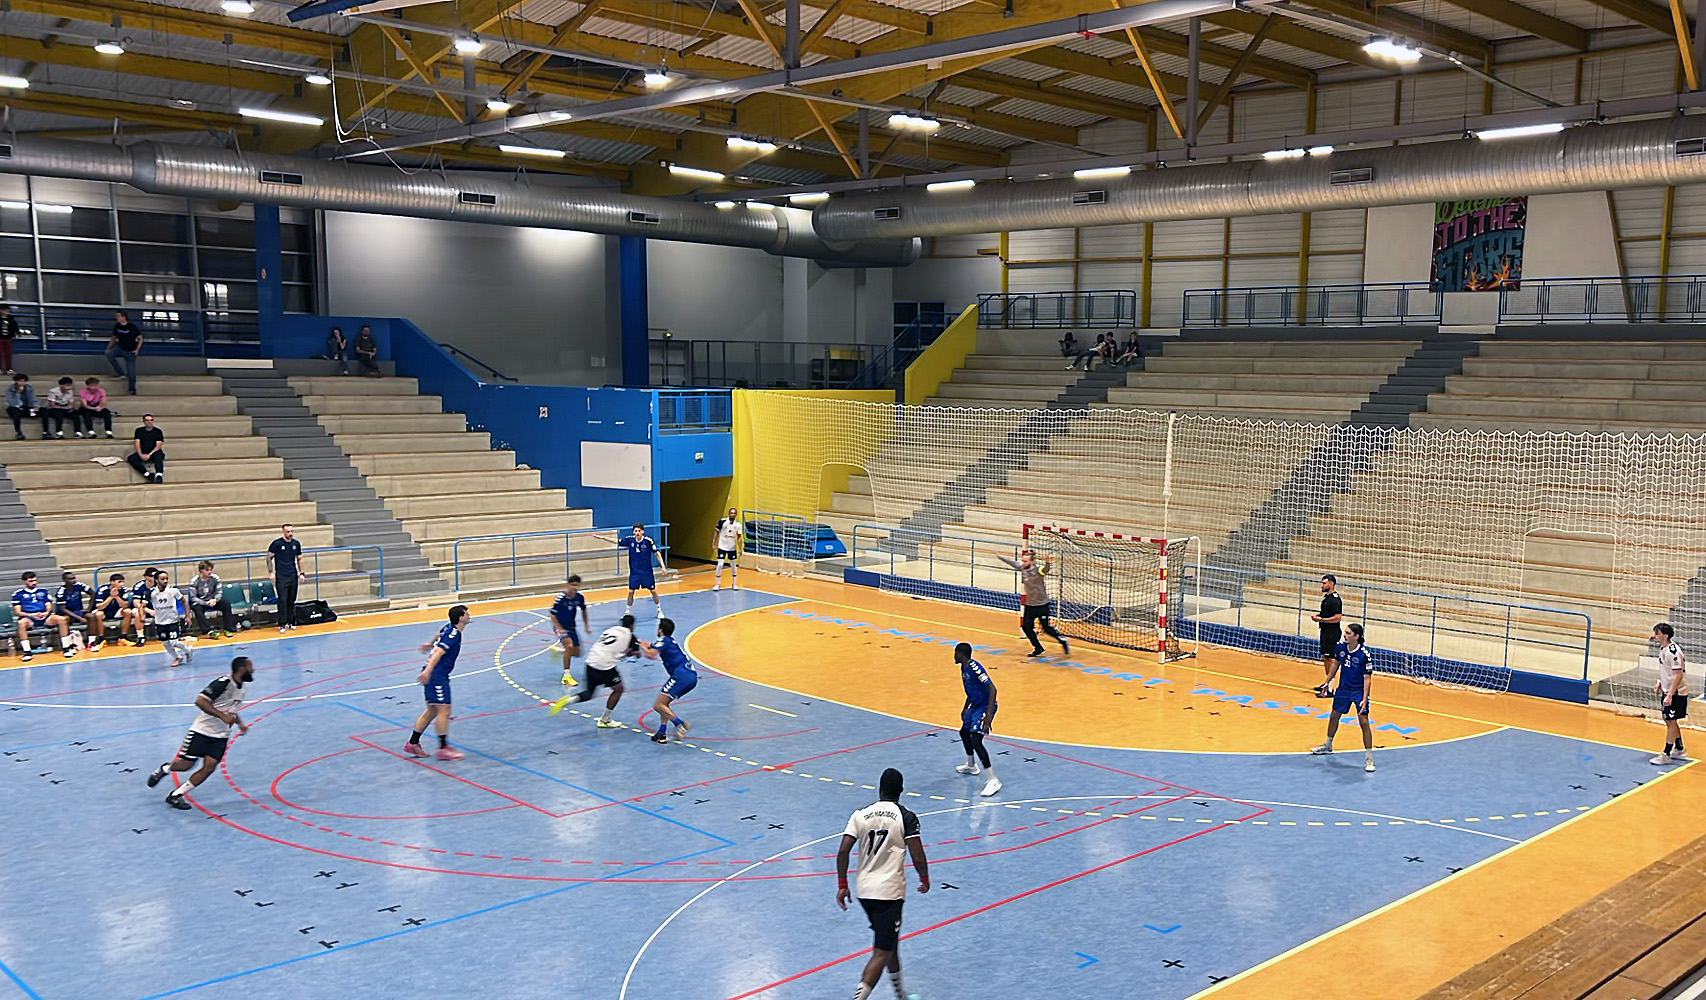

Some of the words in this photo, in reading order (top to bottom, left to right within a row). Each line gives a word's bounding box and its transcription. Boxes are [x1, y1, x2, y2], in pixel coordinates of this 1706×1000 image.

[1436, 214, 1468, 249] TO
[1472, 204, 1521, 235] THE
[1436, 229, 1524, 291] STARS
[867, 829, 889, 856] 17
